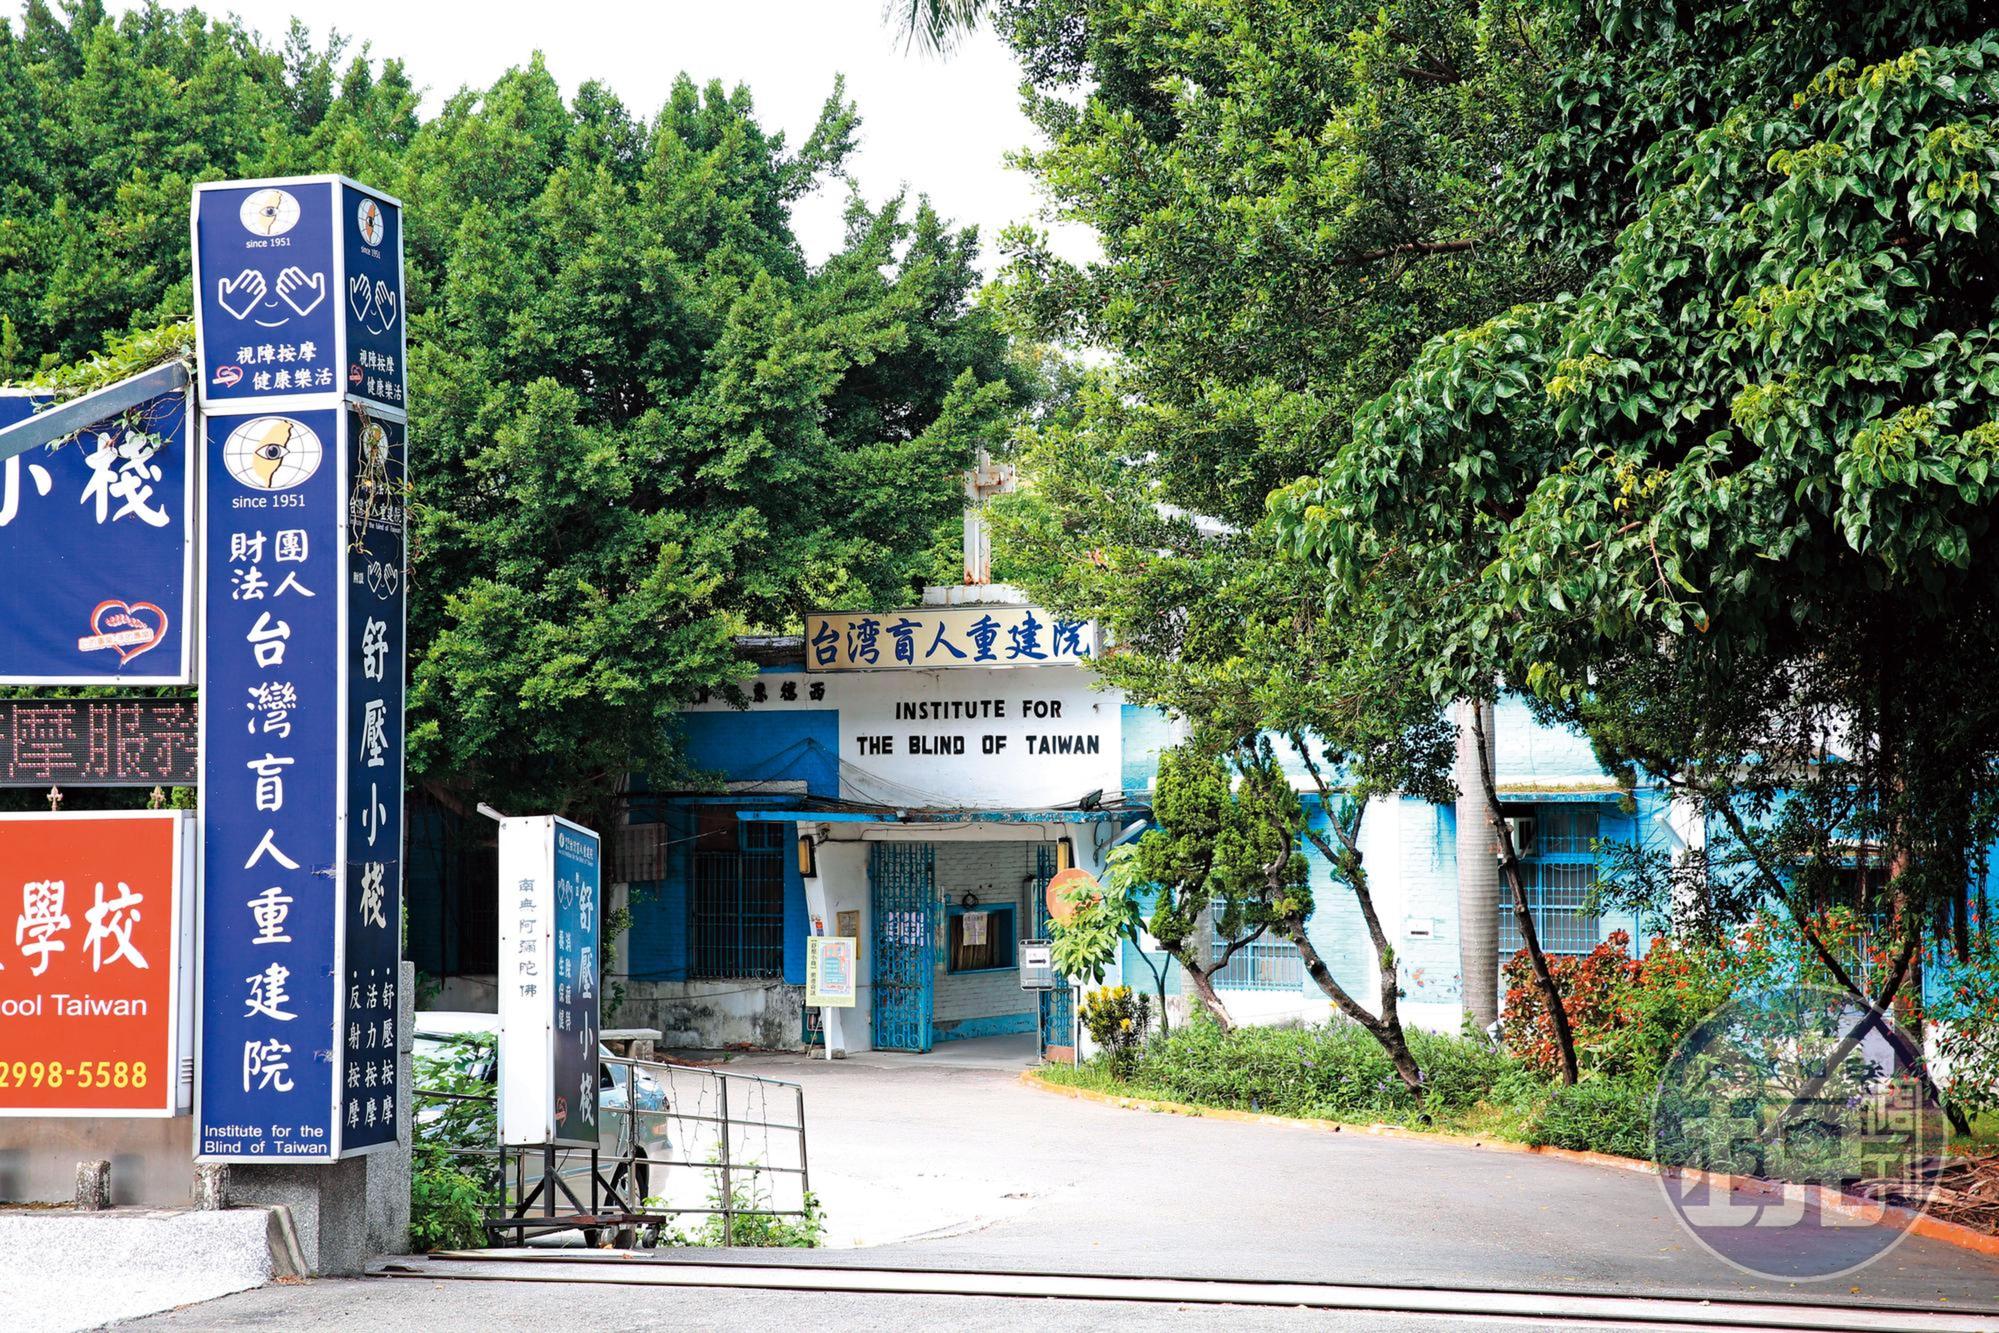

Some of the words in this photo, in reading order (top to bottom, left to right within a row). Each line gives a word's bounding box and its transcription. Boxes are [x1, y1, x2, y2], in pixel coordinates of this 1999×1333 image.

[246, 239, 268, 249] since
[270, 237, 291, 248] 1951
[235, 341, 317, 364] 視障按摩
[359, 348, 395, 375] 視障按摩
[252, 367, 334, 391] 健康樂活
[367, 376, 402, 401] 健康樂活
[232, 495, 267, 509] since
[272, 494, 306, 508] 1951
[229, 529, 309, 564] 財團
[231, 566, 316, 601] 法人
[895, 699, 1005, 720] INSTITUTE
[1022, 699, 1062, 718] FOR
[0, 703, 197, 778] 摩服務
[856, 735, 893, 755] THE
[908, 735, 965, 755] BLIND
[982, 735, 1007, 755] OF
[1026, 735, 1099, 755] TAIWAN
[360, 616, 389, 929] 舒壓小棧
[243, 611, 301, 1093] 台灣盲人重建院
[0, 880, 150, 977] 學校
[51, 994, 147, 1016] Taiwan
[578, 881, 594, 1127] 舒壓小棧
[347, 984, 361, 1130] 反射按摩
[364, 983, 379, 1128] 活力按摩
[381, 981, 395, 1125] 舒壓按摩
[0, 1061, 147, 1089] 2998-5588
[204, 1124, 262, 1137] Institute
[271, 1124, 291, 1137] for
[300, 1125, 323, 1137] the
[204, 1141, 241, 1153] Blind
[250, 1141, 265, 1153] of
[274, 1141, 327, 1154] Taiwan
